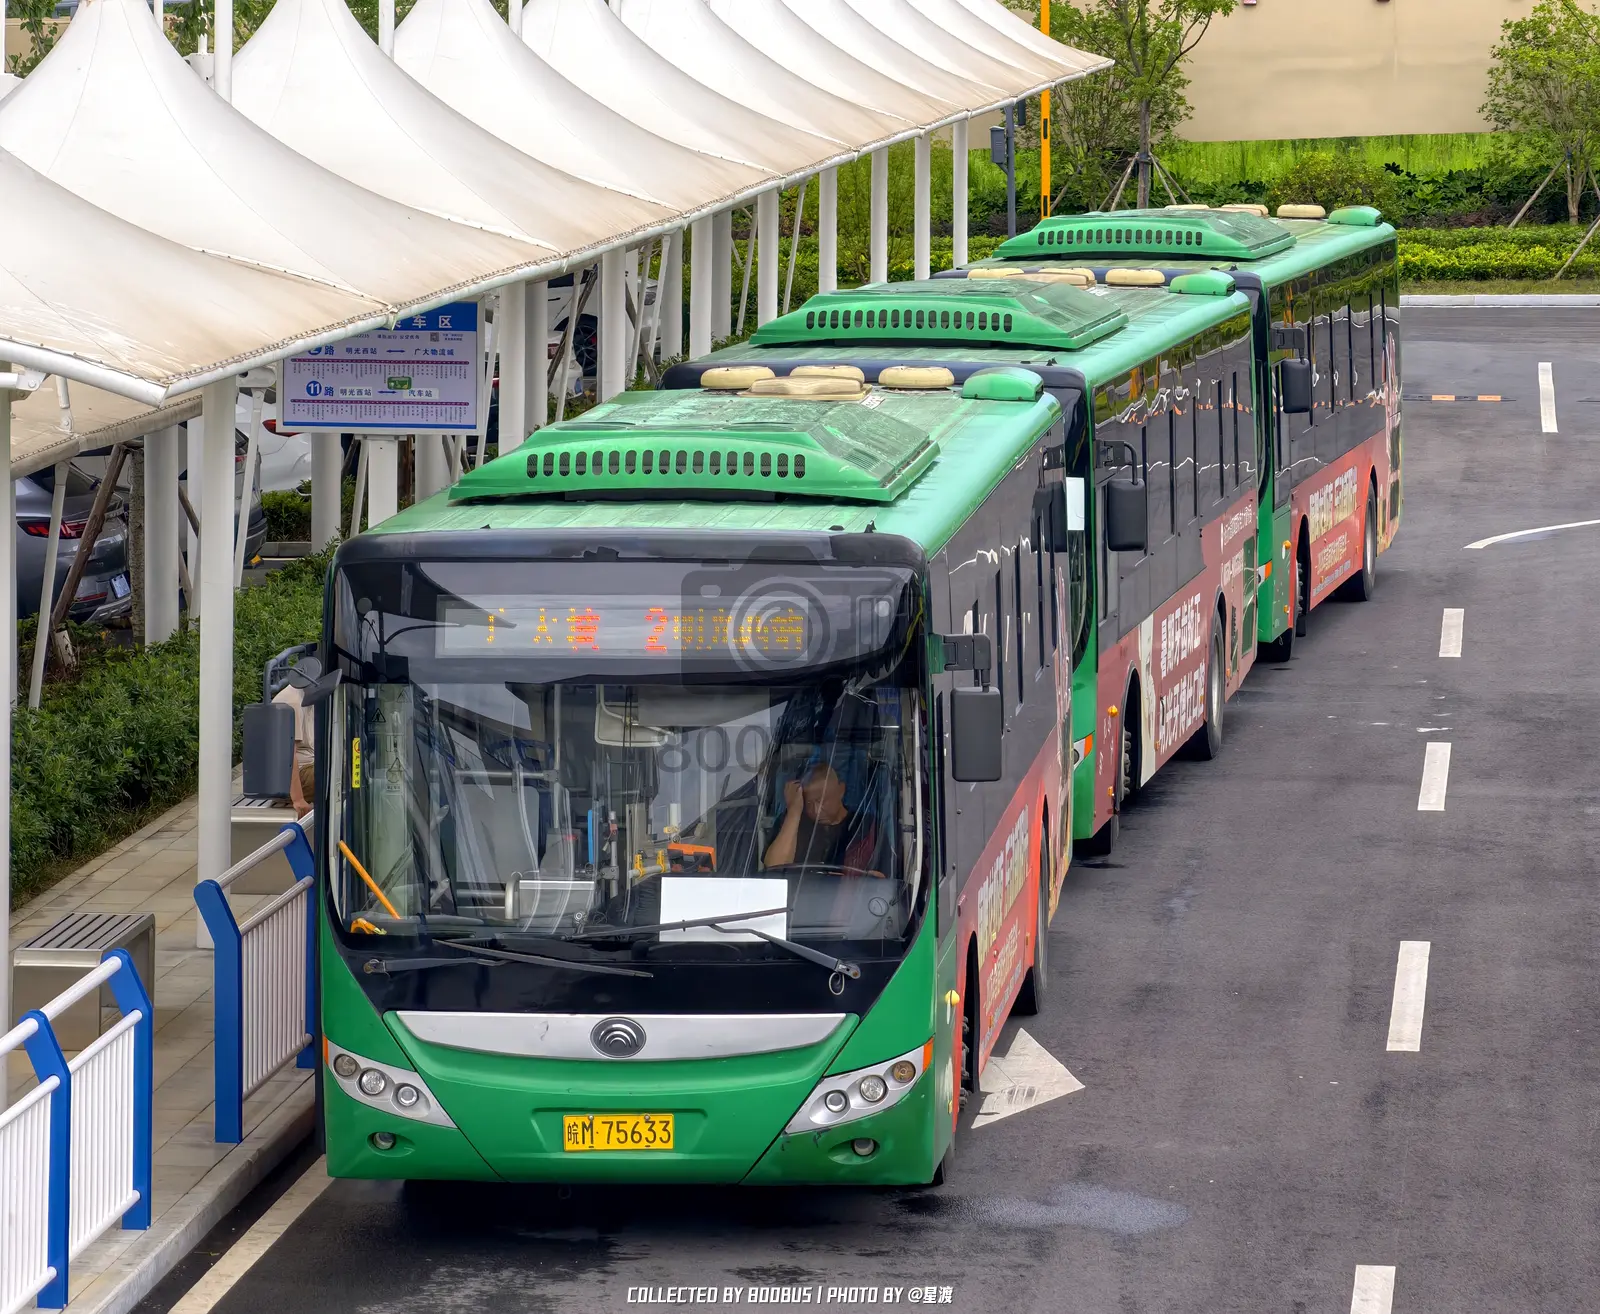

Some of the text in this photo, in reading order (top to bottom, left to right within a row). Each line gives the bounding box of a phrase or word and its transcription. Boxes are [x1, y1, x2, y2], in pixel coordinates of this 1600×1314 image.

[395, 314, 453, 329] 车区
[345, 347, 378, 355] 明光西站
[414, 348, 454, 356] 广大物流城
[308, 384, 320, 395] 11
[339, 388, 372, 397] 明光西站
[408, 390, 433, 398] 汽车站
